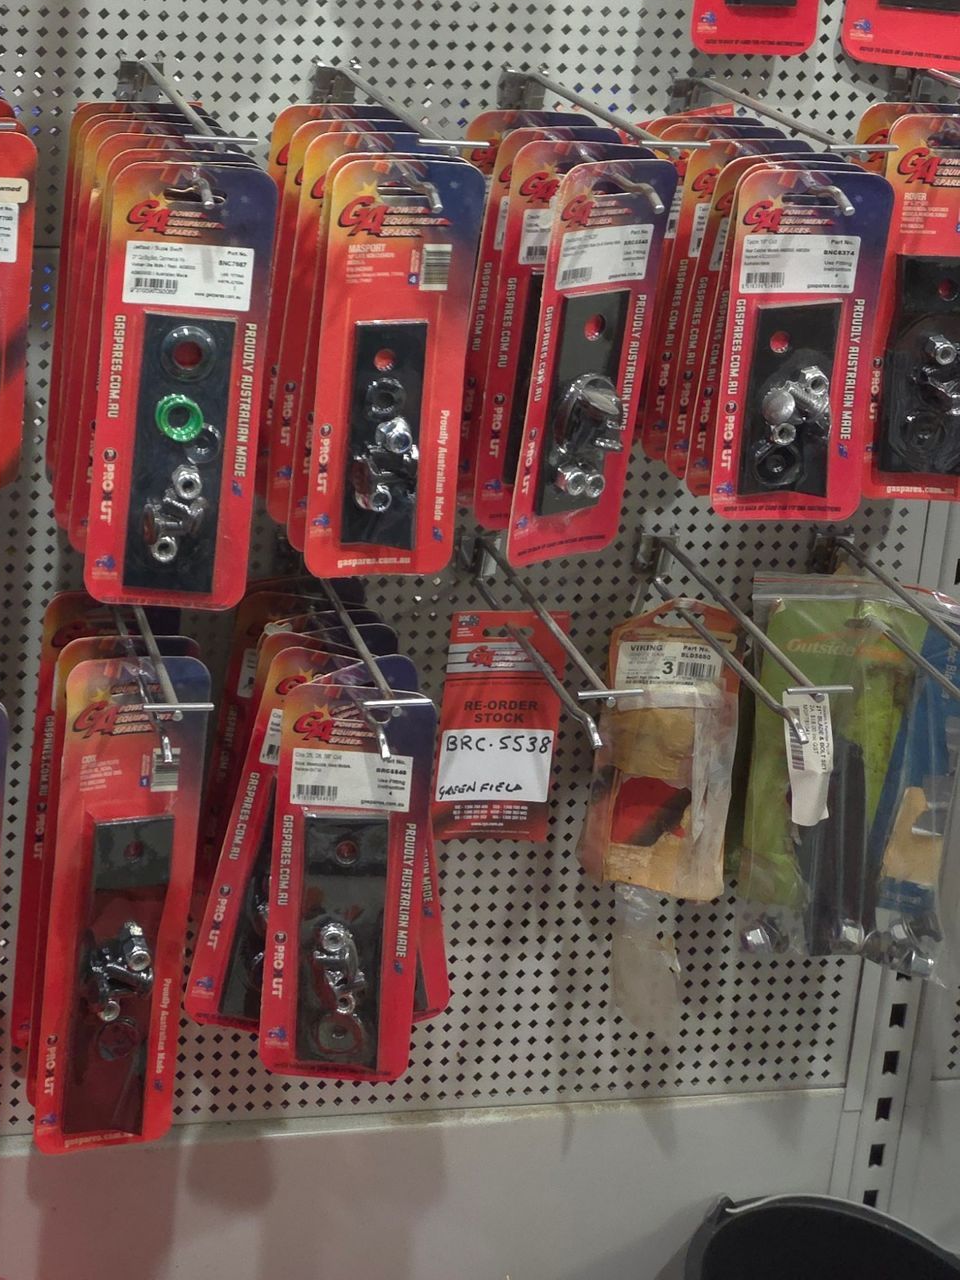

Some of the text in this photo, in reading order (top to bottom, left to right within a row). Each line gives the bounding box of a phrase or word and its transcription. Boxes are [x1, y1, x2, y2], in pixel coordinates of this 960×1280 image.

[897, 147, 941, 184] GA
[410, 276, 417, 284] 4
[107, 315, 127, 418] GASPARES.COM.AU
[727, 298, 747, 395] GASPARES.COM.AU
[839, 298, 865, 440] PROUDLY AUSTRALIAN MADE
[233, 322, 257, 477] PROUDLY AUSTRALIAN MADE
[433, 409, 450, 521] Proudly Australian Made
[630, 644, 664, 652] VIKING
[662, 661, 674, 675] 3
[463, 701, 539, 711] RE-ORDER
[474, 713, 525, 723] STOCK
[277, 815, 294, 907] GASPARES.COM.AU
[395, 823, 417, 959] PROUDLY AUSTRALIAN MADE
